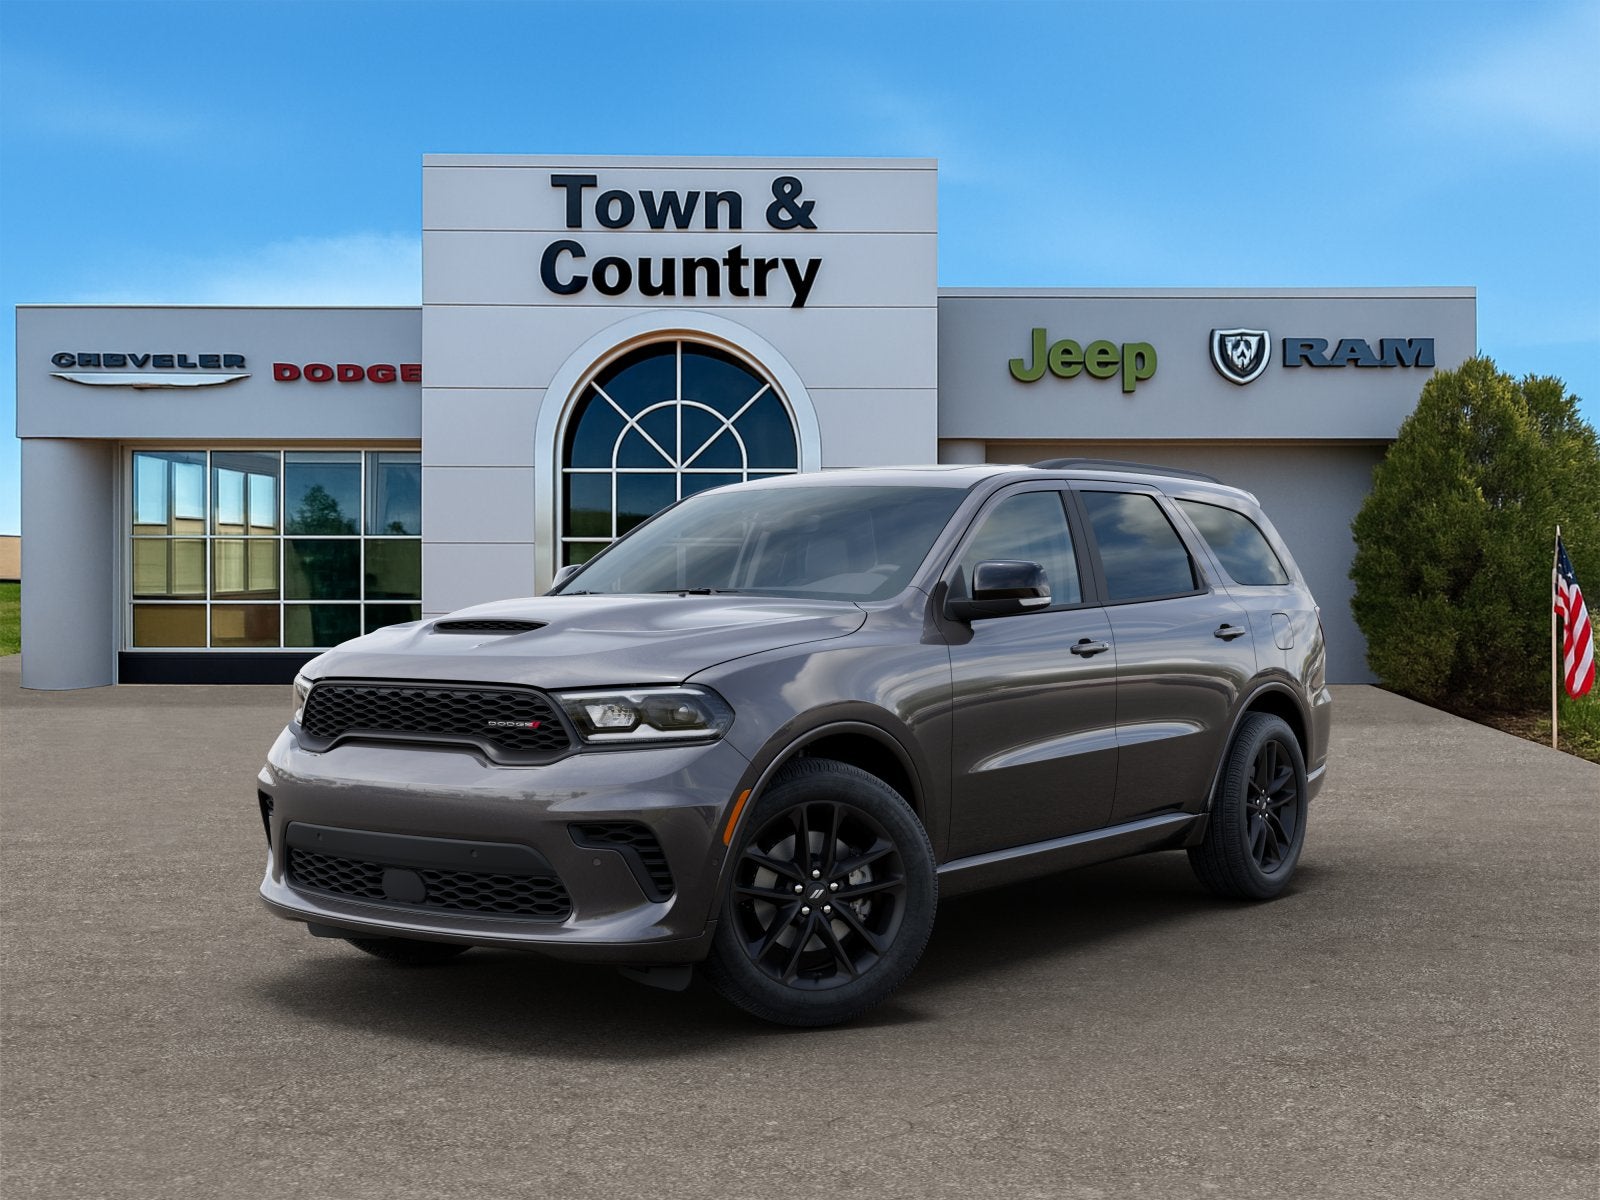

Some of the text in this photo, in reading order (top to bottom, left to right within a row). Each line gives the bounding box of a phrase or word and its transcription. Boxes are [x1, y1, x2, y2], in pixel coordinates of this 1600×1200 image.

[550, 174, 818, 230] Town &
[540, 239, 822, 308] Country
[1009, 328, 1157, 392] Jeep
[1282, 337, 1435, 368] RAM
